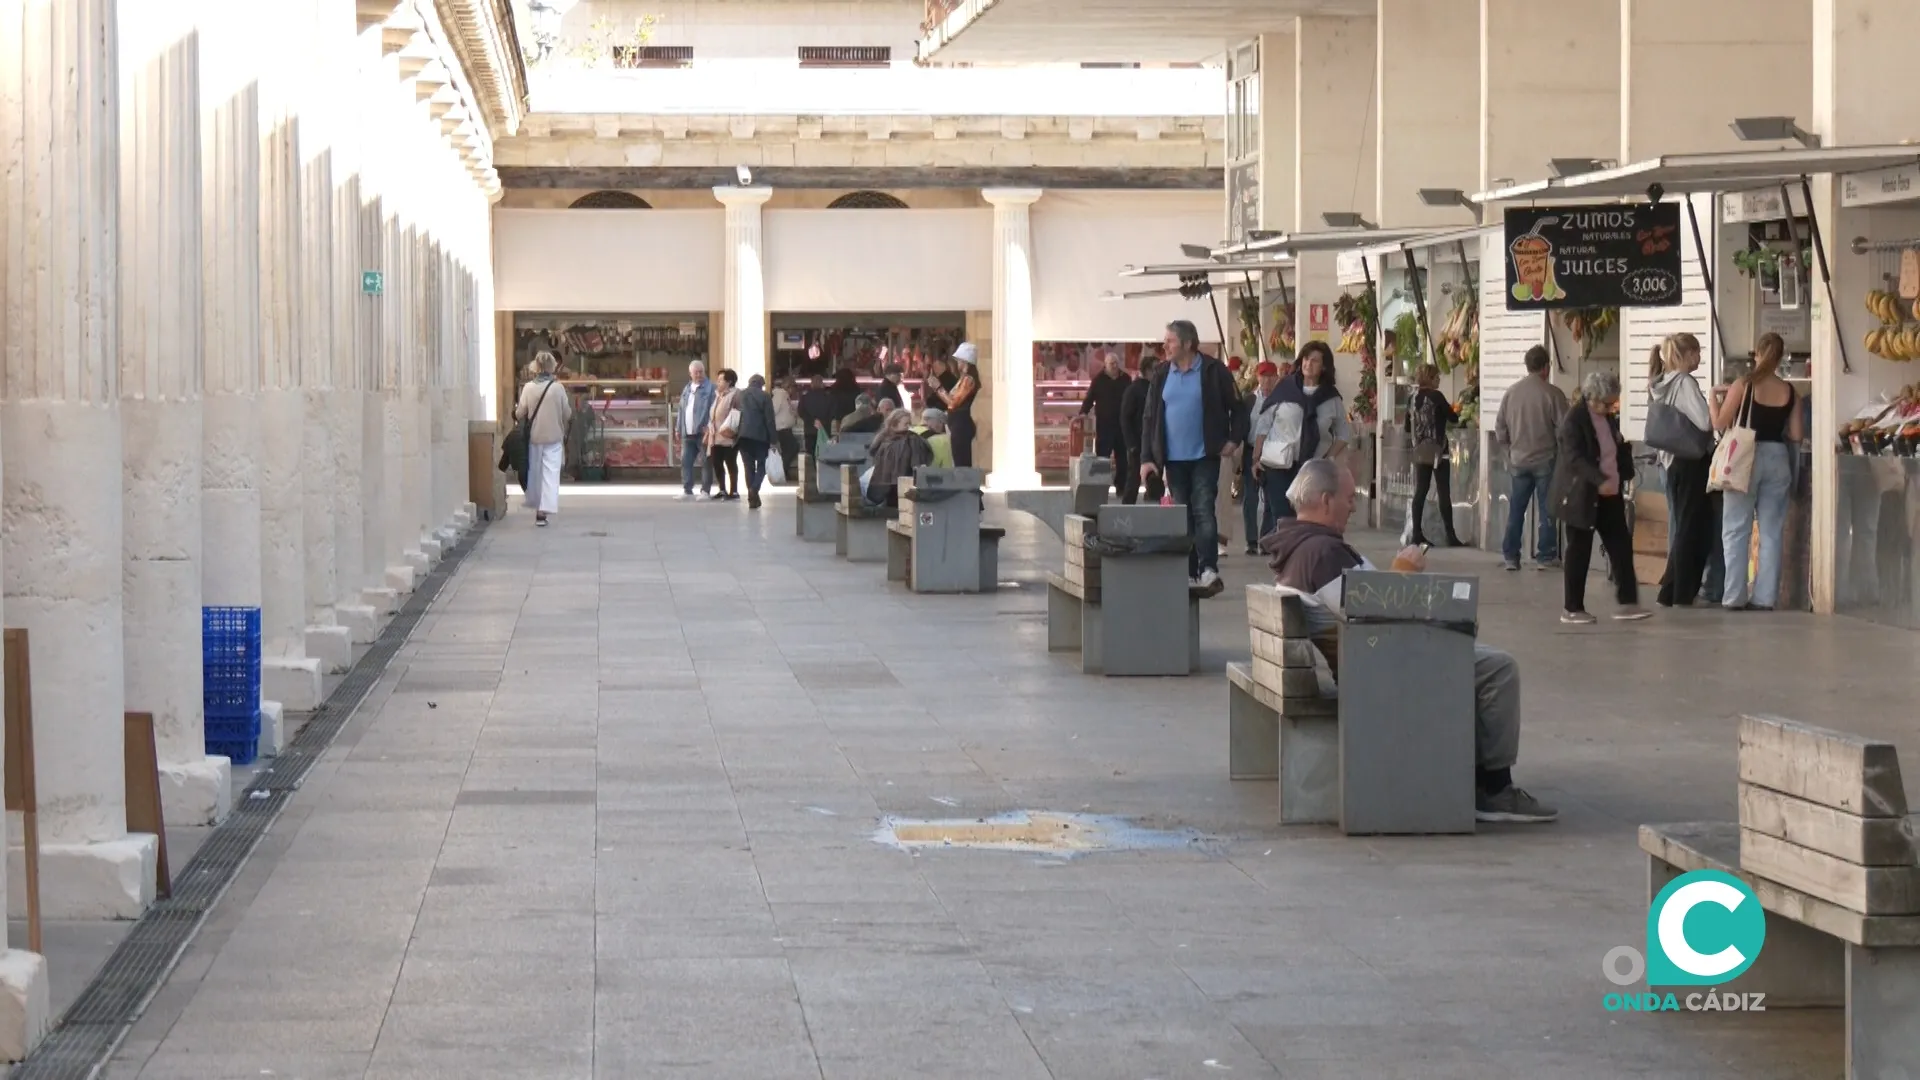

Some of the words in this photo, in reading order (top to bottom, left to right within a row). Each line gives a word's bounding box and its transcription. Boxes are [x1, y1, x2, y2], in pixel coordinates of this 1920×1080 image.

[1562, 211, 1635, 229] ZUMOS
[1582, 231, 1632, 241] NATURALES
[1559, 246, 1597, 255] NATURAL
[1560, 257, 1629, 276] JUICES
[1632, 277, 1668, 295] 3,00€
